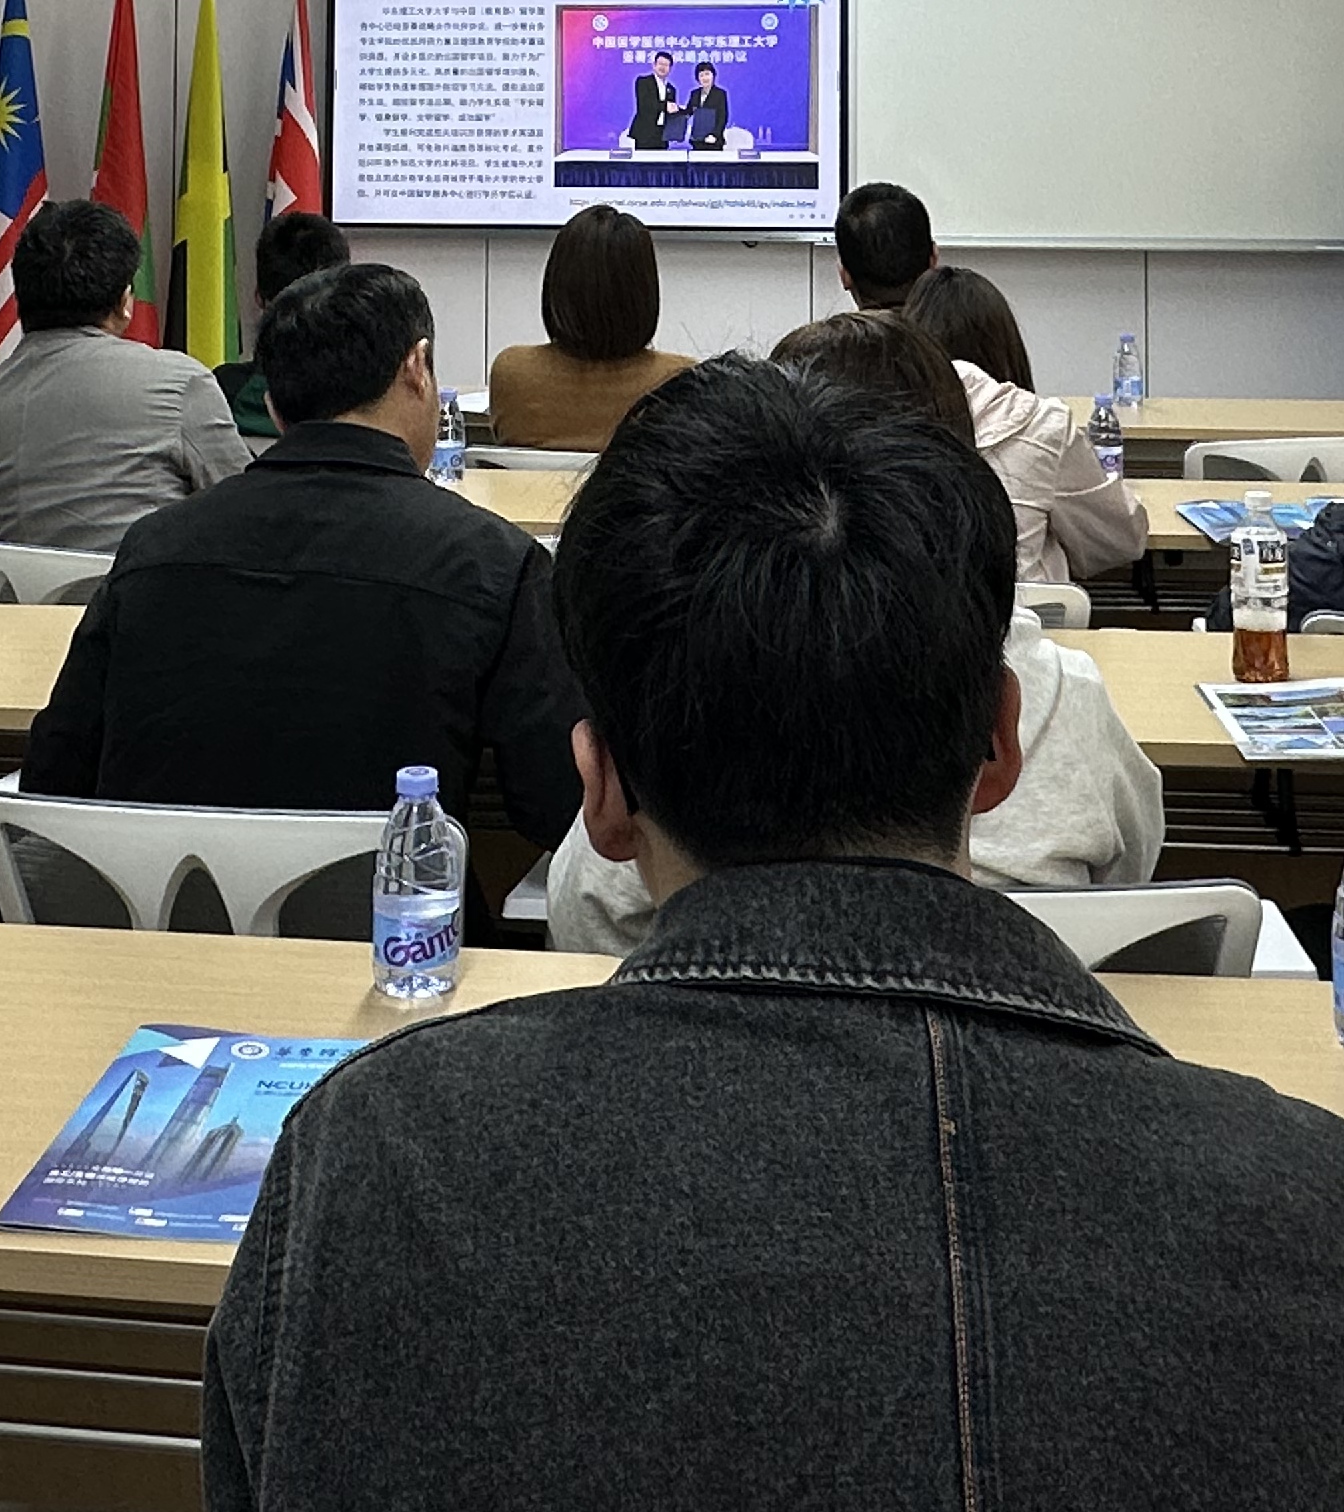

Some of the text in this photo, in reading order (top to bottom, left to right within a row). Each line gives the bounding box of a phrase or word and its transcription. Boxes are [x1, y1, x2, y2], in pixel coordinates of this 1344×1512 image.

[622, 50, 748, 64] 签署全战略合作协议
